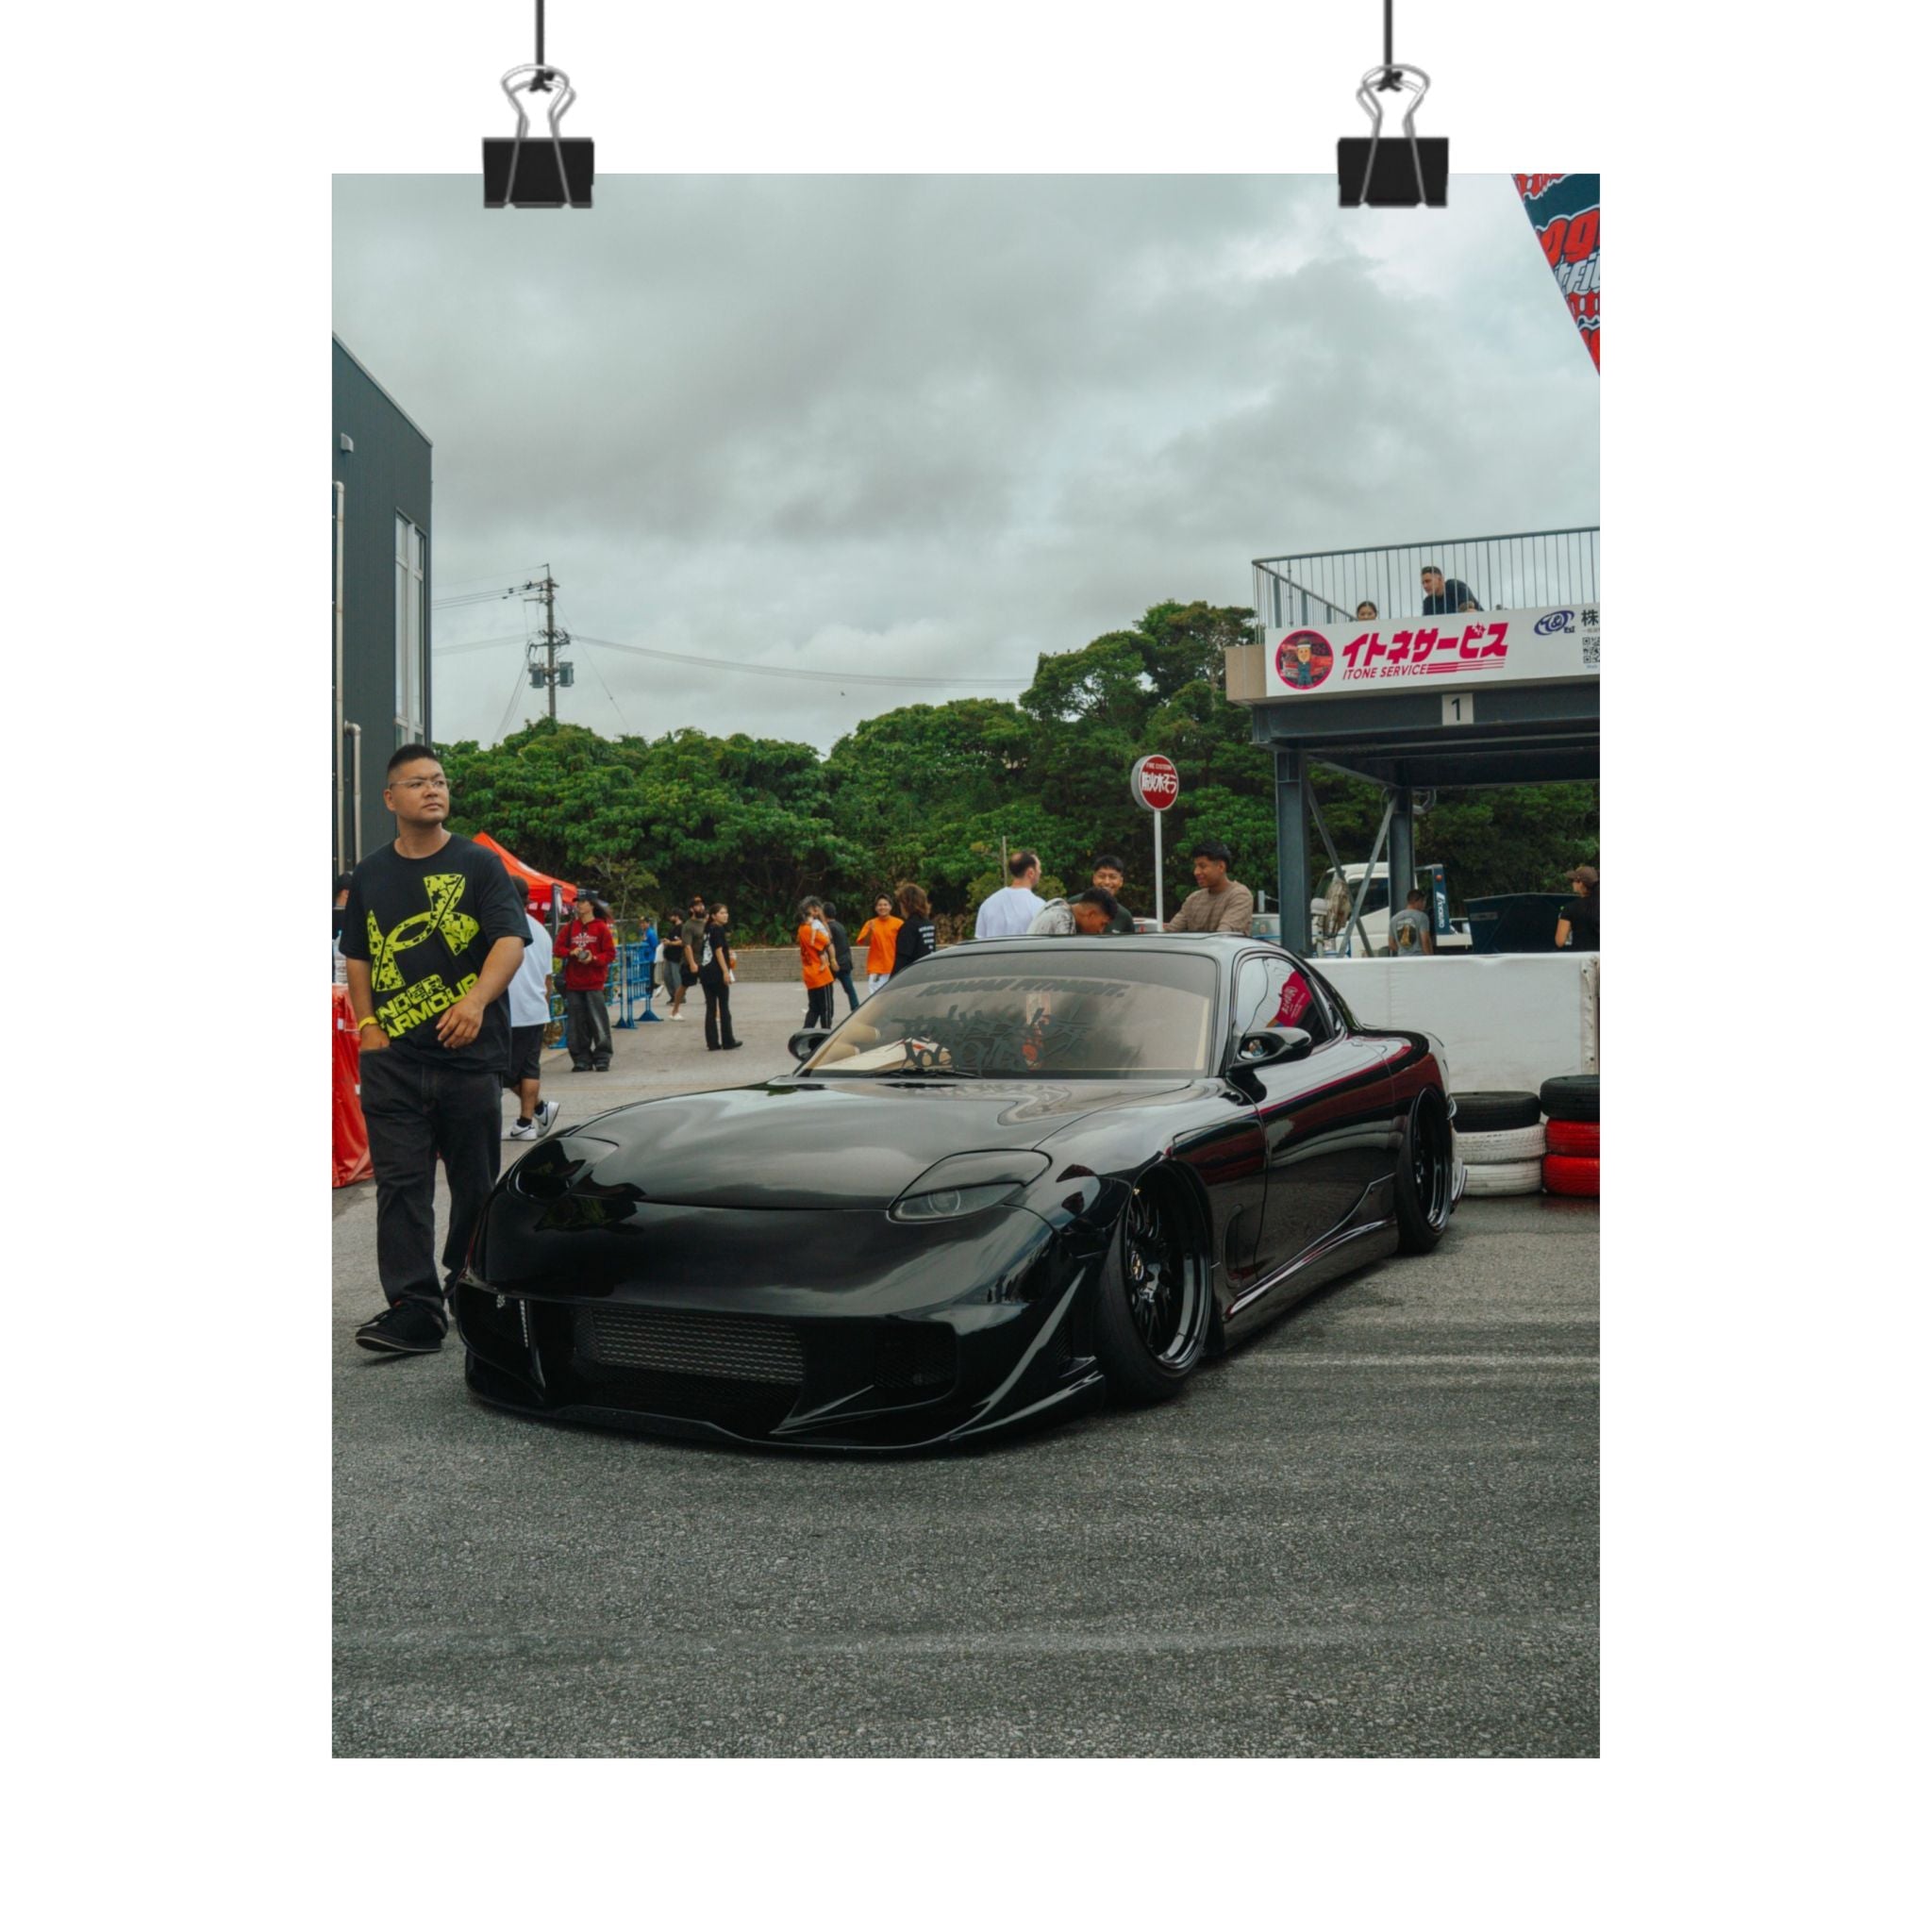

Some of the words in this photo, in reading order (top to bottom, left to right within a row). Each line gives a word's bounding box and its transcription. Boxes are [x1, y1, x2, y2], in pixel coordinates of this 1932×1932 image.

[1341, 623, 1509, 669] イトネサービス
[1342, 667, 1378, 680] ITONE
[1379, 664, 1427, 677] SERVICE
[1450, 697, 1461, 722] 1
[375, 974, 446, 1019] NDER
